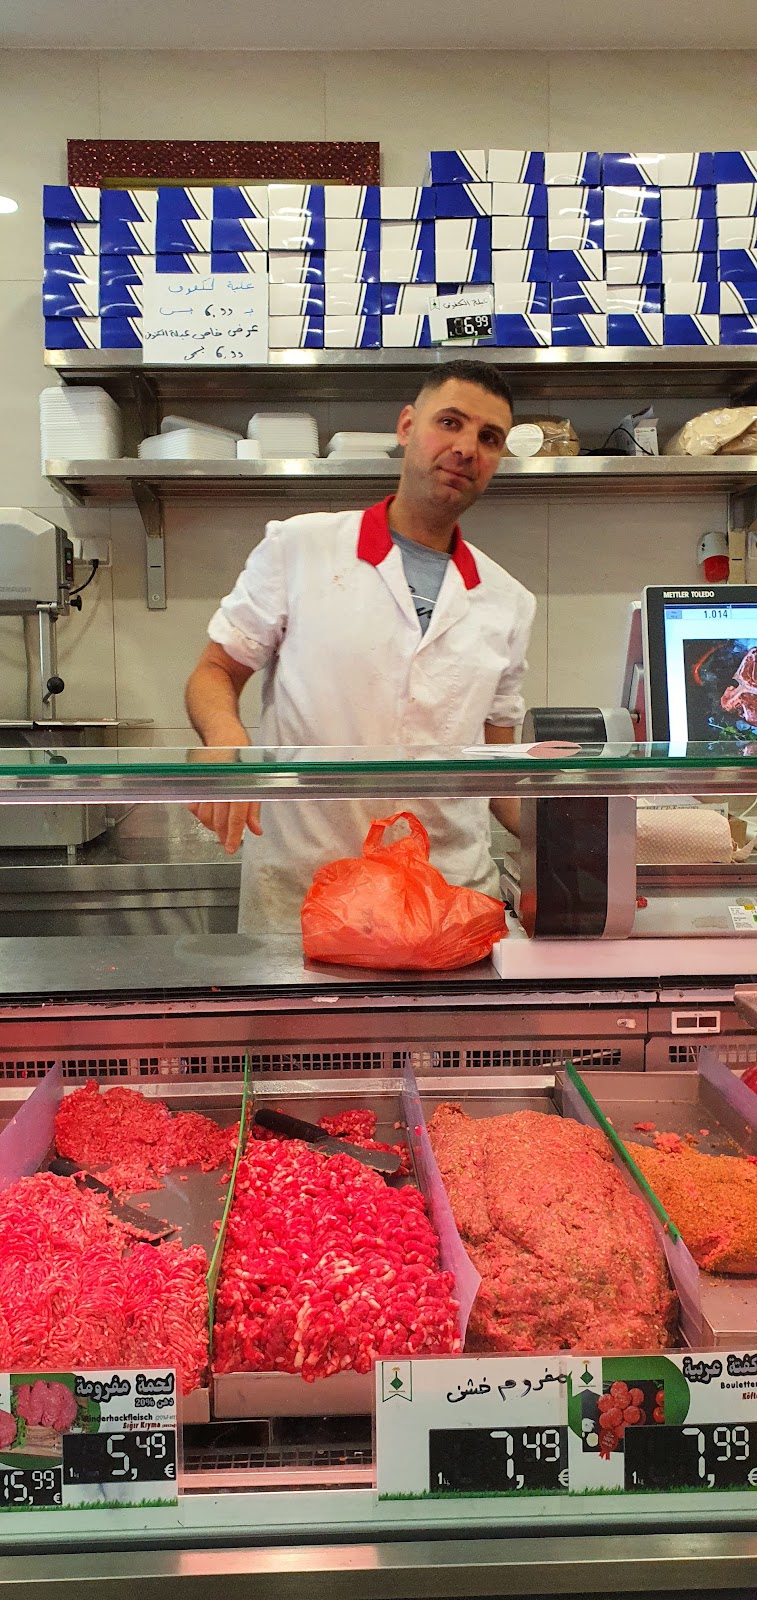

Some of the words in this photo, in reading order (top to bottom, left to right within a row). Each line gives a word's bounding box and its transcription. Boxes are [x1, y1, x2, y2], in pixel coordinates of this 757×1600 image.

[191, 327, 223, 339] خاص
[227, 323, 259, 338] عرض
[663, 591, 690, 599] METTLER
[691, 590, 715, 598] TOLEDO
[704, 609, 728, 619] 1.014
[682, 1356, 723, 1384] عربية
[74, 1375, 131, 1403] مفرومة
[135, 1372, 175, 1395] لحمة
[446, 1377, 491, 1403] خشن
[742, 1391, 757, 1400] Köft
[106, 1432, 166, 1480] 5,49
[164, 1463, 175, 1478] €
[489, 1429, 561, 1489] 7,49
[681, 1425, 750, 1489] 7,99
[3, 1470, 55, 1505] 15,99
[53, 1492, 62, 1504] €
